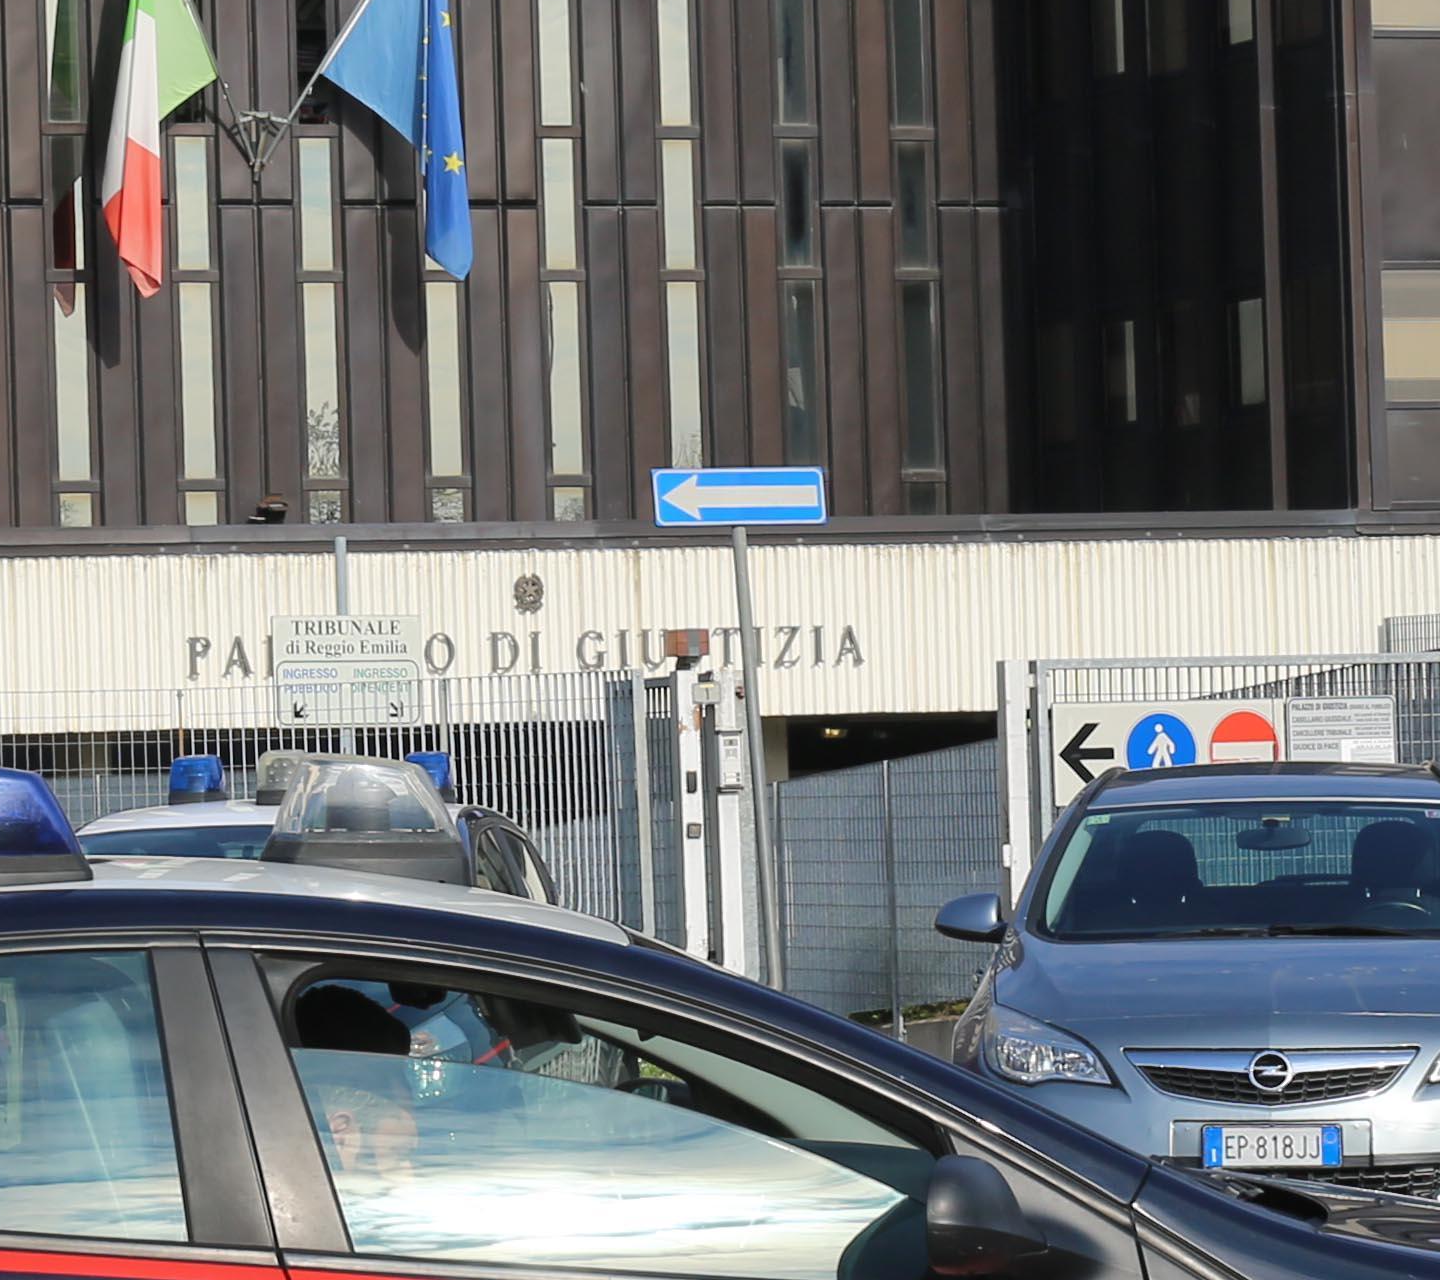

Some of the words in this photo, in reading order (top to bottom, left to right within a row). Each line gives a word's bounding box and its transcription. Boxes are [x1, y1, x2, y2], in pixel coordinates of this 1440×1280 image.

[291, 620, 401, 636] TRIBUNALE
[286, 639, 300, 654] di
[305, 640, 355, 658] Reggio
[360, 639, 408, 655] Emilia
[487, 630, 543, 676] DI
[576, 625, 866, 671] GIUTIZIA
[282, 668, 338, 679] INGRESSO
[353, 667, 408, 679] INGRESSO
[1225, 1135, 1248, 1160] EP
[1255, 1135, 1320, 1160] 818JJ
